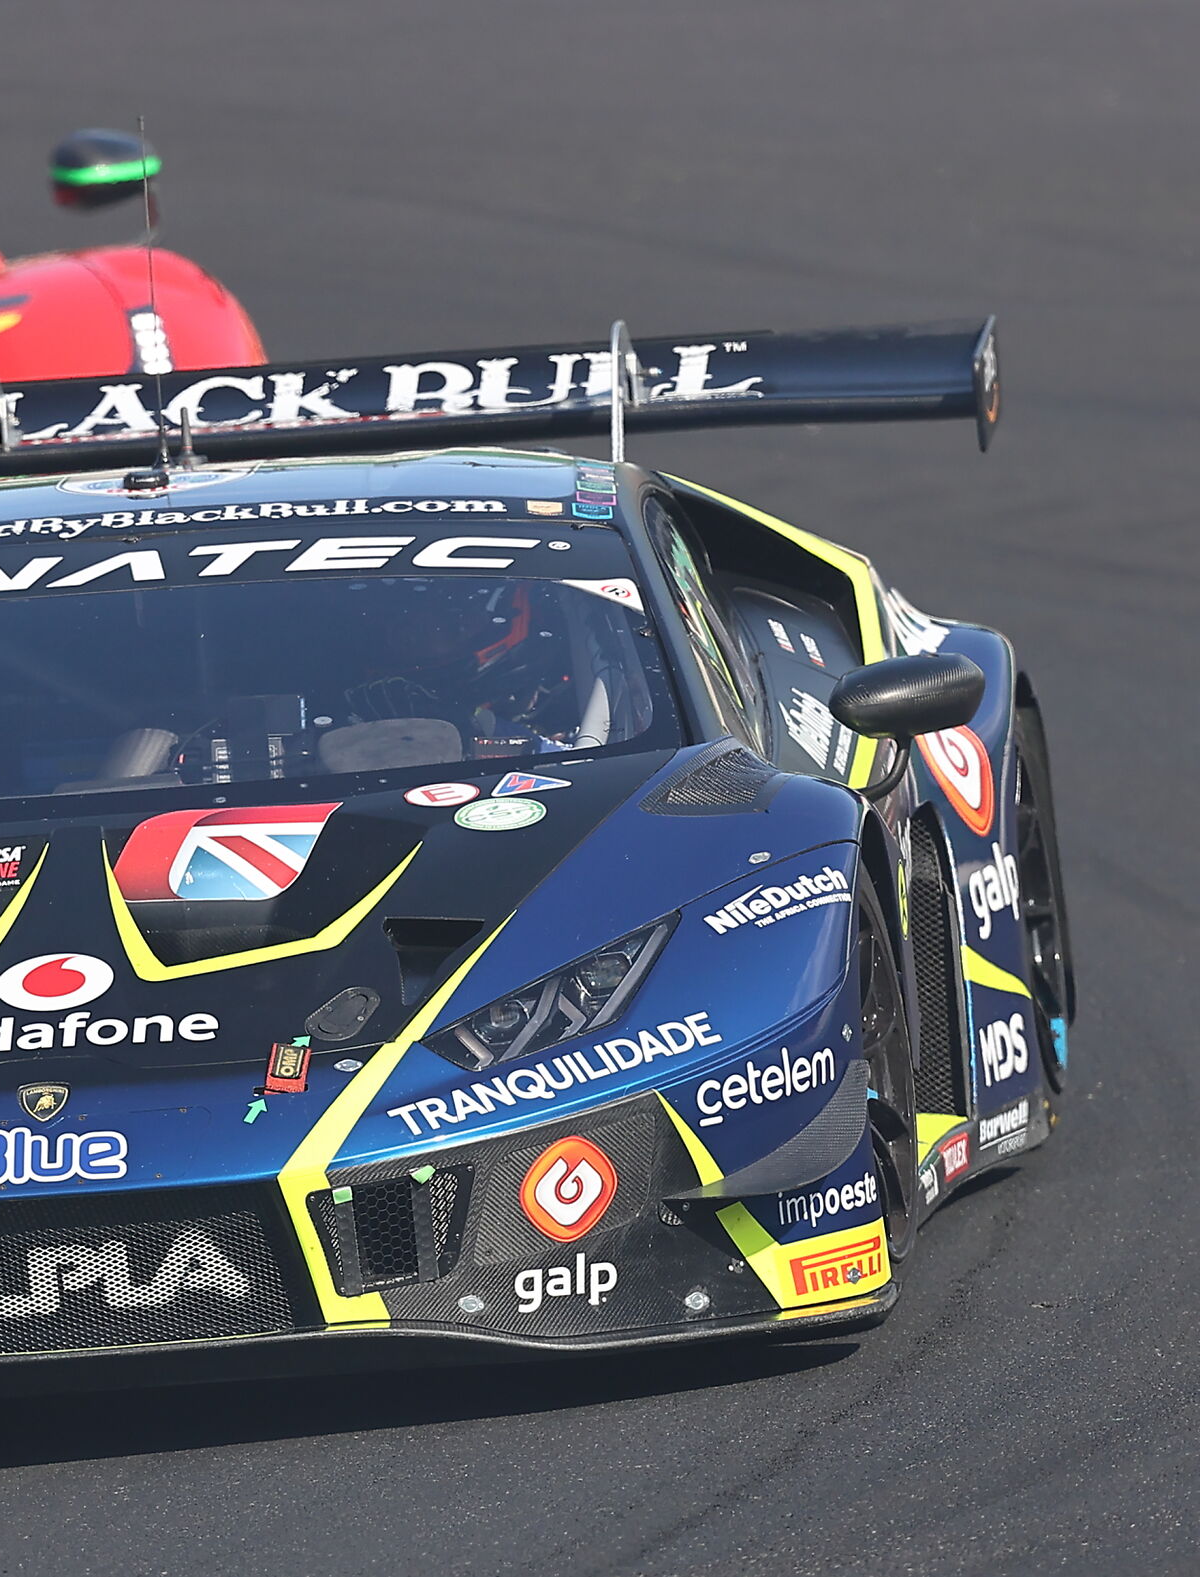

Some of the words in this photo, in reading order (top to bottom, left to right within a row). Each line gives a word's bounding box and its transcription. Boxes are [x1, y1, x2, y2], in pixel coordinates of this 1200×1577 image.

[754, 915, 775, 928] THE
[774, 903, 808, 921] AFRICA
[969, 842, 1020, 940] galp
[280, 1048, 298, 1077] OMP
[387, 1011, 723, 1136] TRANQUILIDADE
[979, 1012, 1028, 1087] MDS
[779, 1172, 878, 1228] impoeste
[514, 1252, 618, 1314] galp
[789, 1235, 882, 1296] PIRELLI
